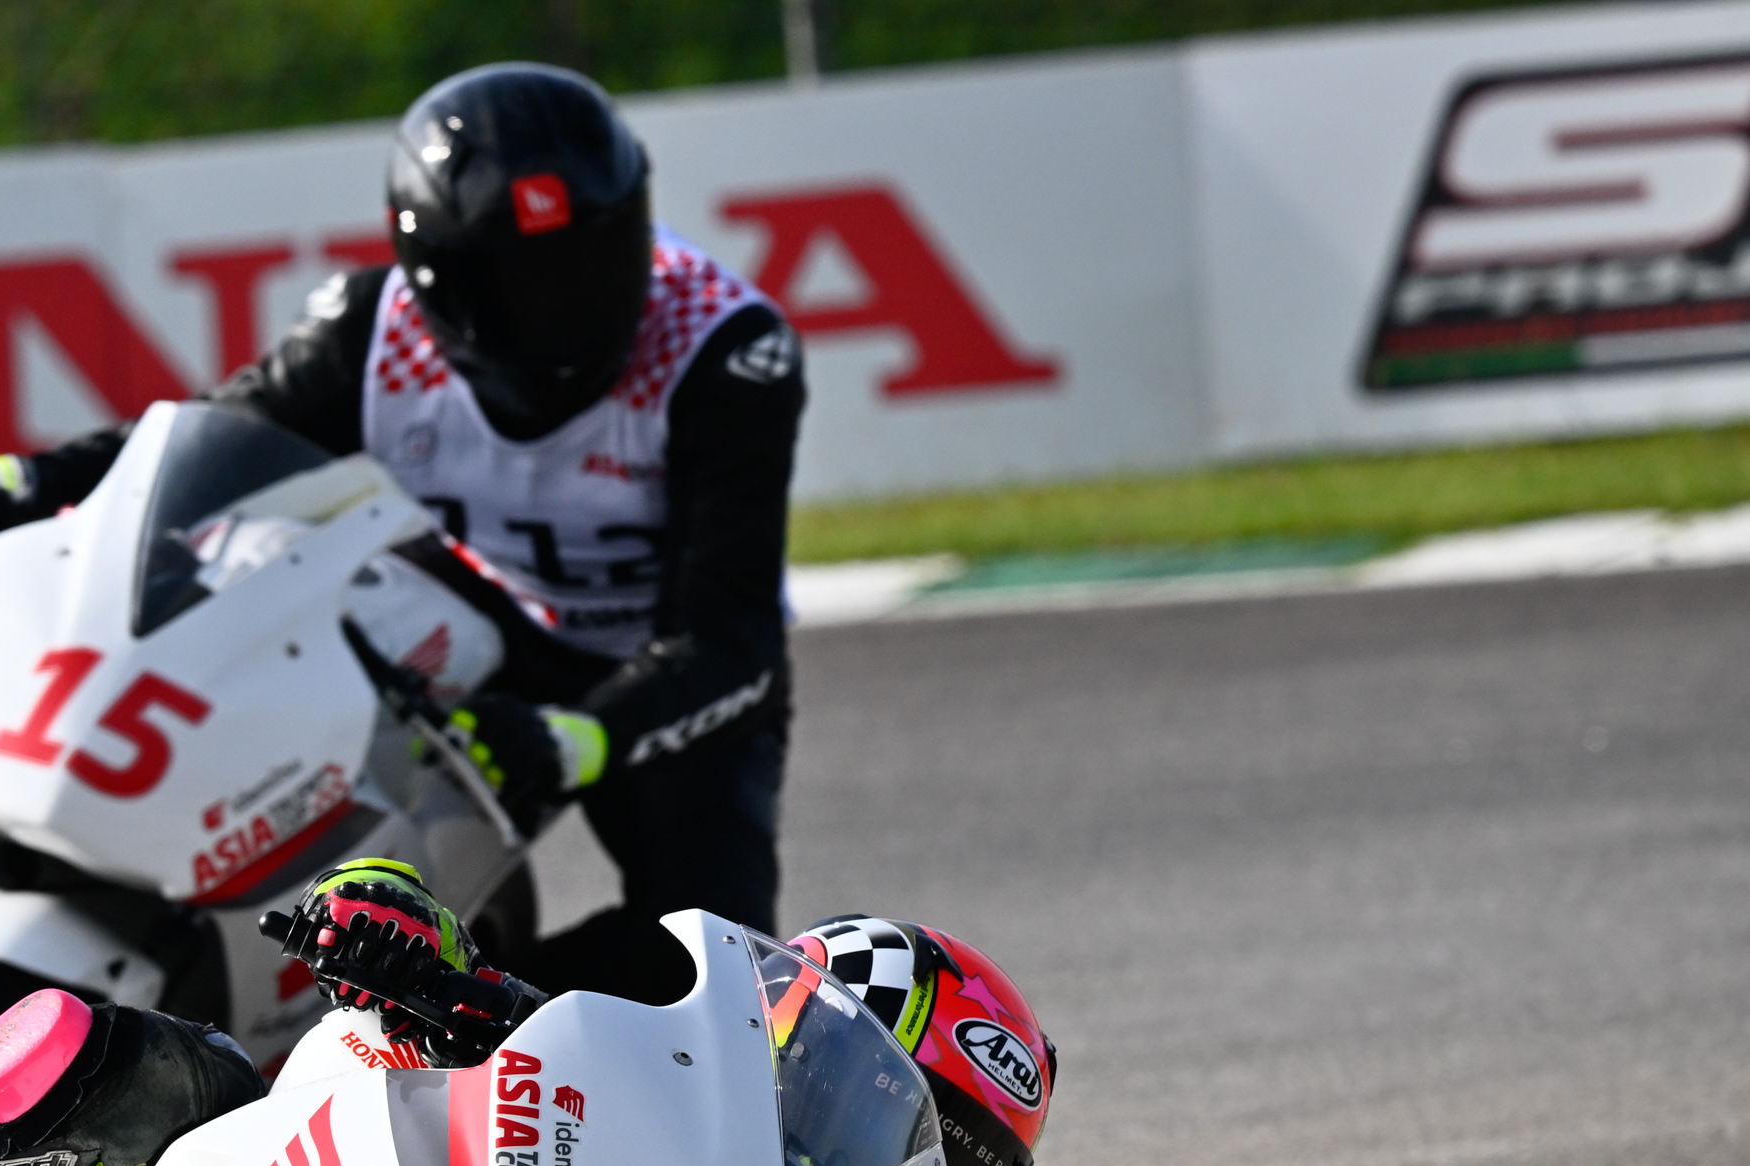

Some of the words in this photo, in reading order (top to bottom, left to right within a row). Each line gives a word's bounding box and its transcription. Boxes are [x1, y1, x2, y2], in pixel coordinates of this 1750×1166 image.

[192, 815, 276, 892] ASIA
[340, 1031, 389, 1069] HON
[961, 1033, 1038, 1096] Arai
[496, 1049, 542, 1148] ASIA
[976, 1145, 995, 1166] BE
